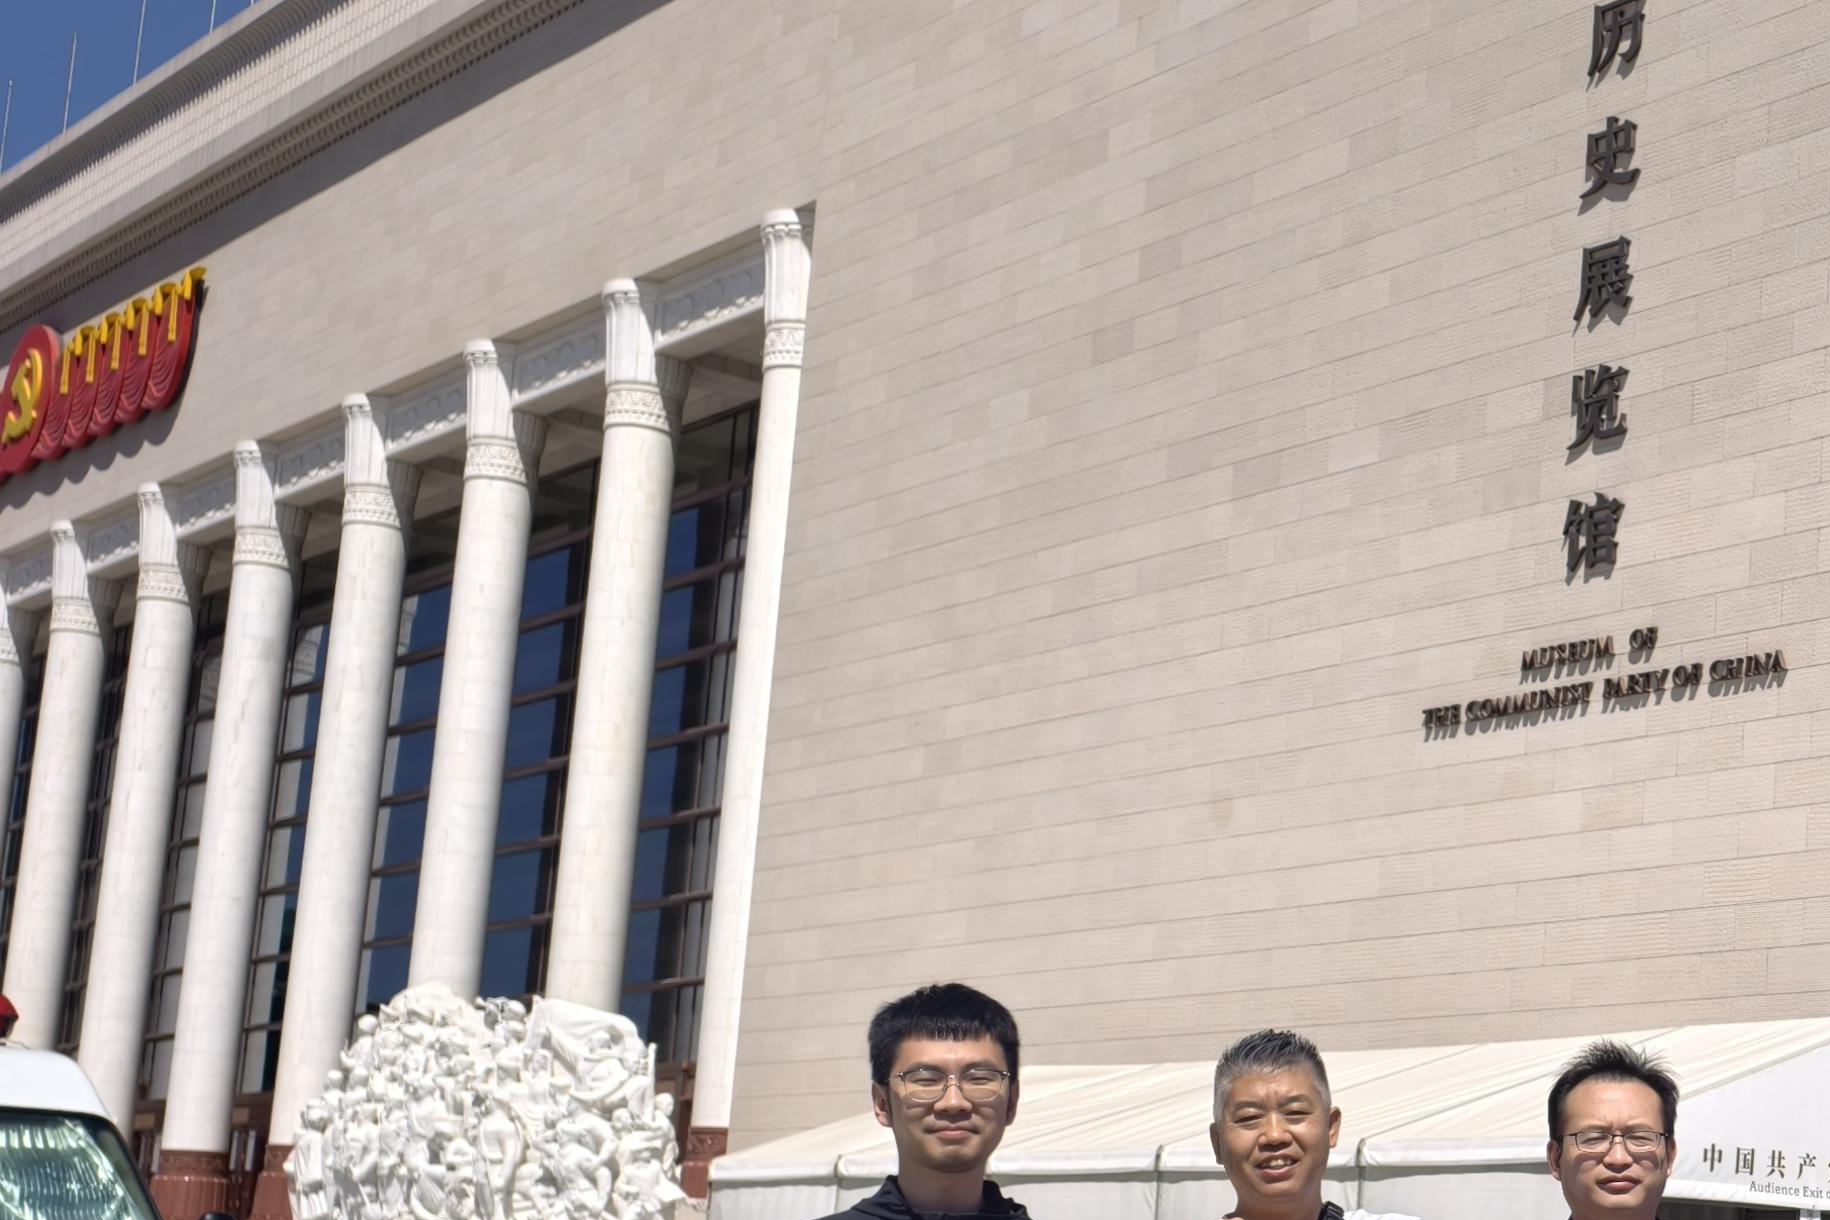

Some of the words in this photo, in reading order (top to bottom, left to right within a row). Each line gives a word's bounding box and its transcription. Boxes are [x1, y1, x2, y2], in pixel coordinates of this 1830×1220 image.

[1563, 0, 1646, 574] 历史展览馆
[1520, 634, 1616, 674] MUSEUM
[1628, 626, 1659, 652] OF
[1421, 703, 1462, 730] THE
[1464, 681, 1595, 721] COMMUNIST
[1602, 667, 1670, 699] PARTY
[1672, 662, 1703, 688] OF
[1708, 649, 1790, 682] CHINA
[1749, 1181, 1800, 1197] Audience
[1802, 1186, 1824, 1199] Exit
